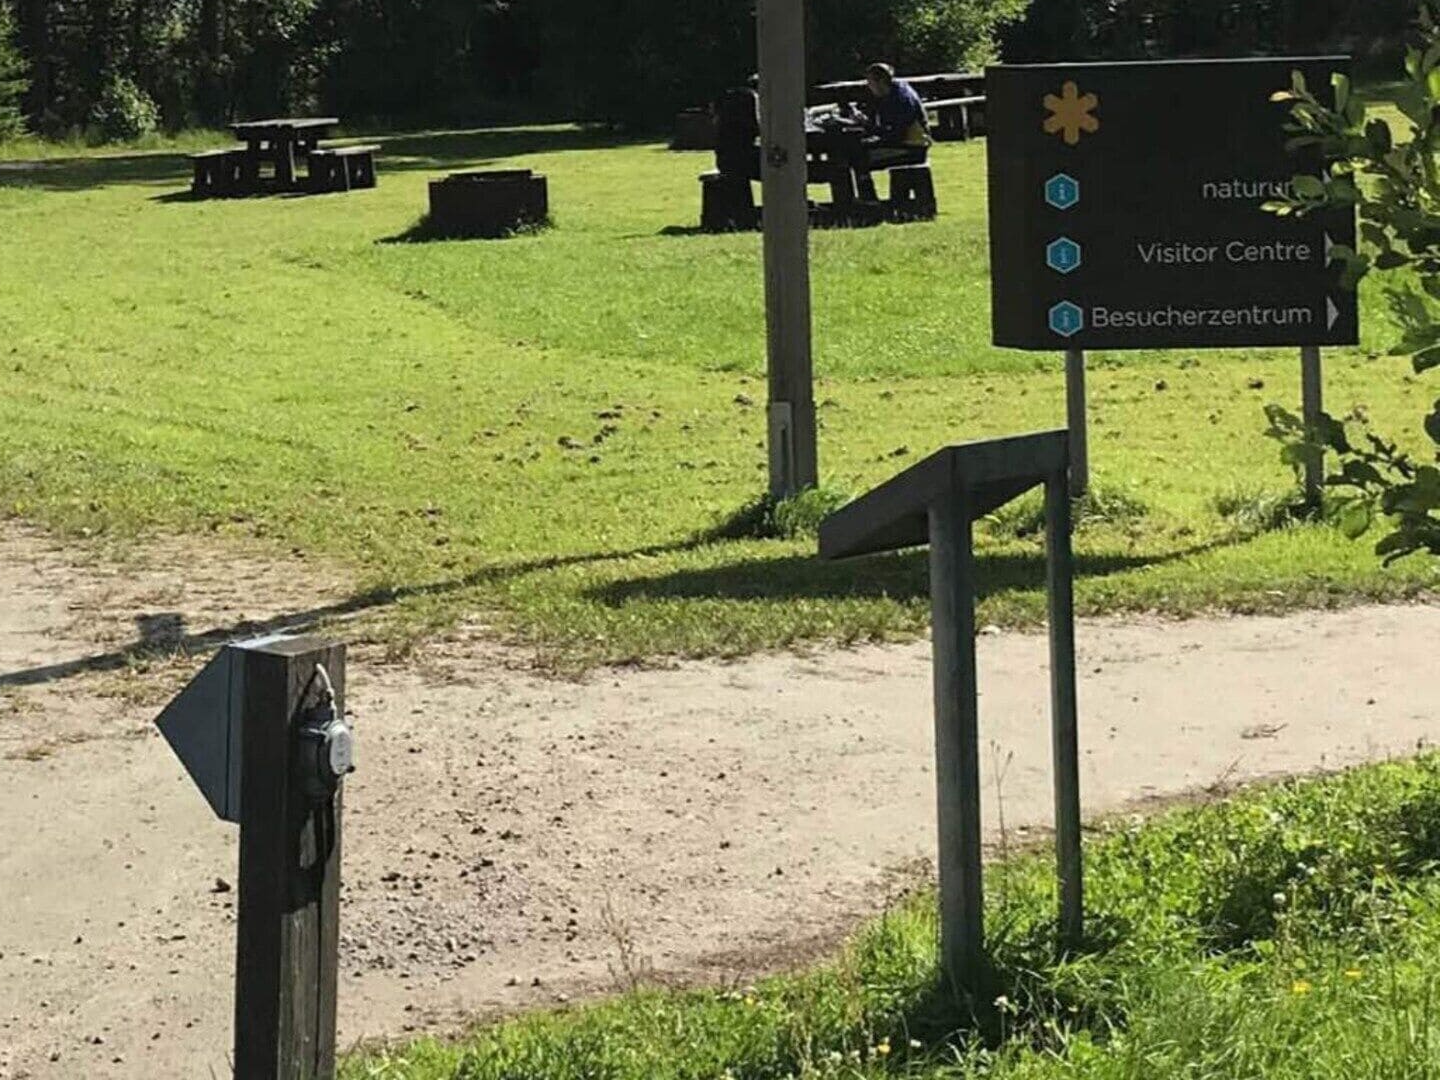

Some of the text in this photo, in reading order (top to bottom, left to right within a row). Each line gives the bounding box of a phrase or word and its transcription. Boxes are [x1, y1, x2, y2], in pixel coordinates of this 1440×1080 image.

[1202, 178, 1300, 199] naturu
[1137, 238, 1311, 264] Visitor Centre
[1092, 304, 1312, 328] Besucherzentrum
